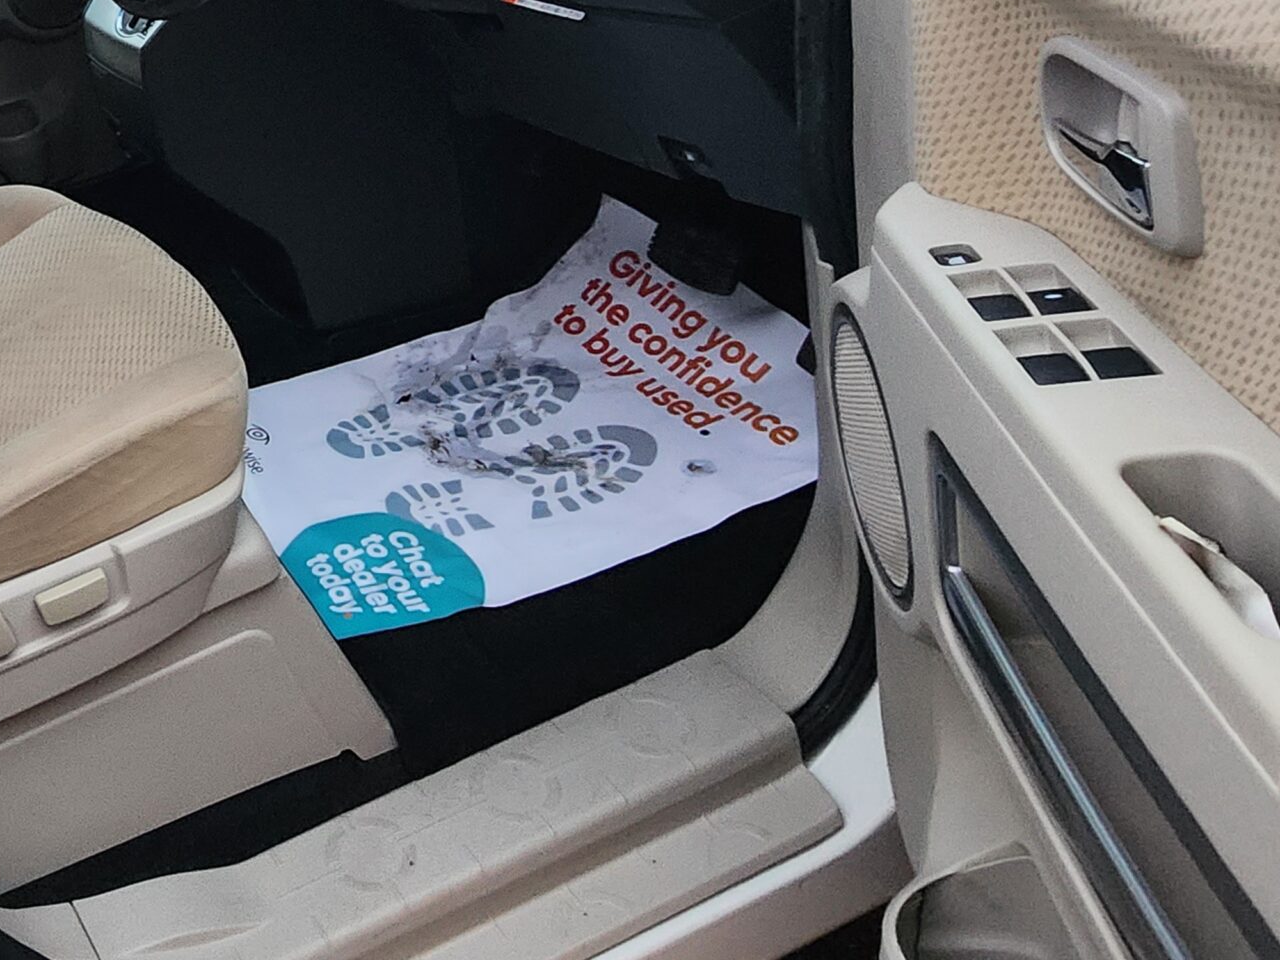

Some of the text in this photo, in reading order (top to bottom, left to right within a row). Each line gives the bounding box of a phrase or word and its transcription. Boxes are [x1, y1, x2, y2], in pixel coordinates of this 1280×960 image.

[580, 277, 799, 446] the confidence
[608, 249, 772, 383] Giving you
[553, 304, 725, 436] to buy used.
[333, 543, 398, 614] dealer
[360, 533, 431, 612] to your
[388, 531, 445, 588] Chat
